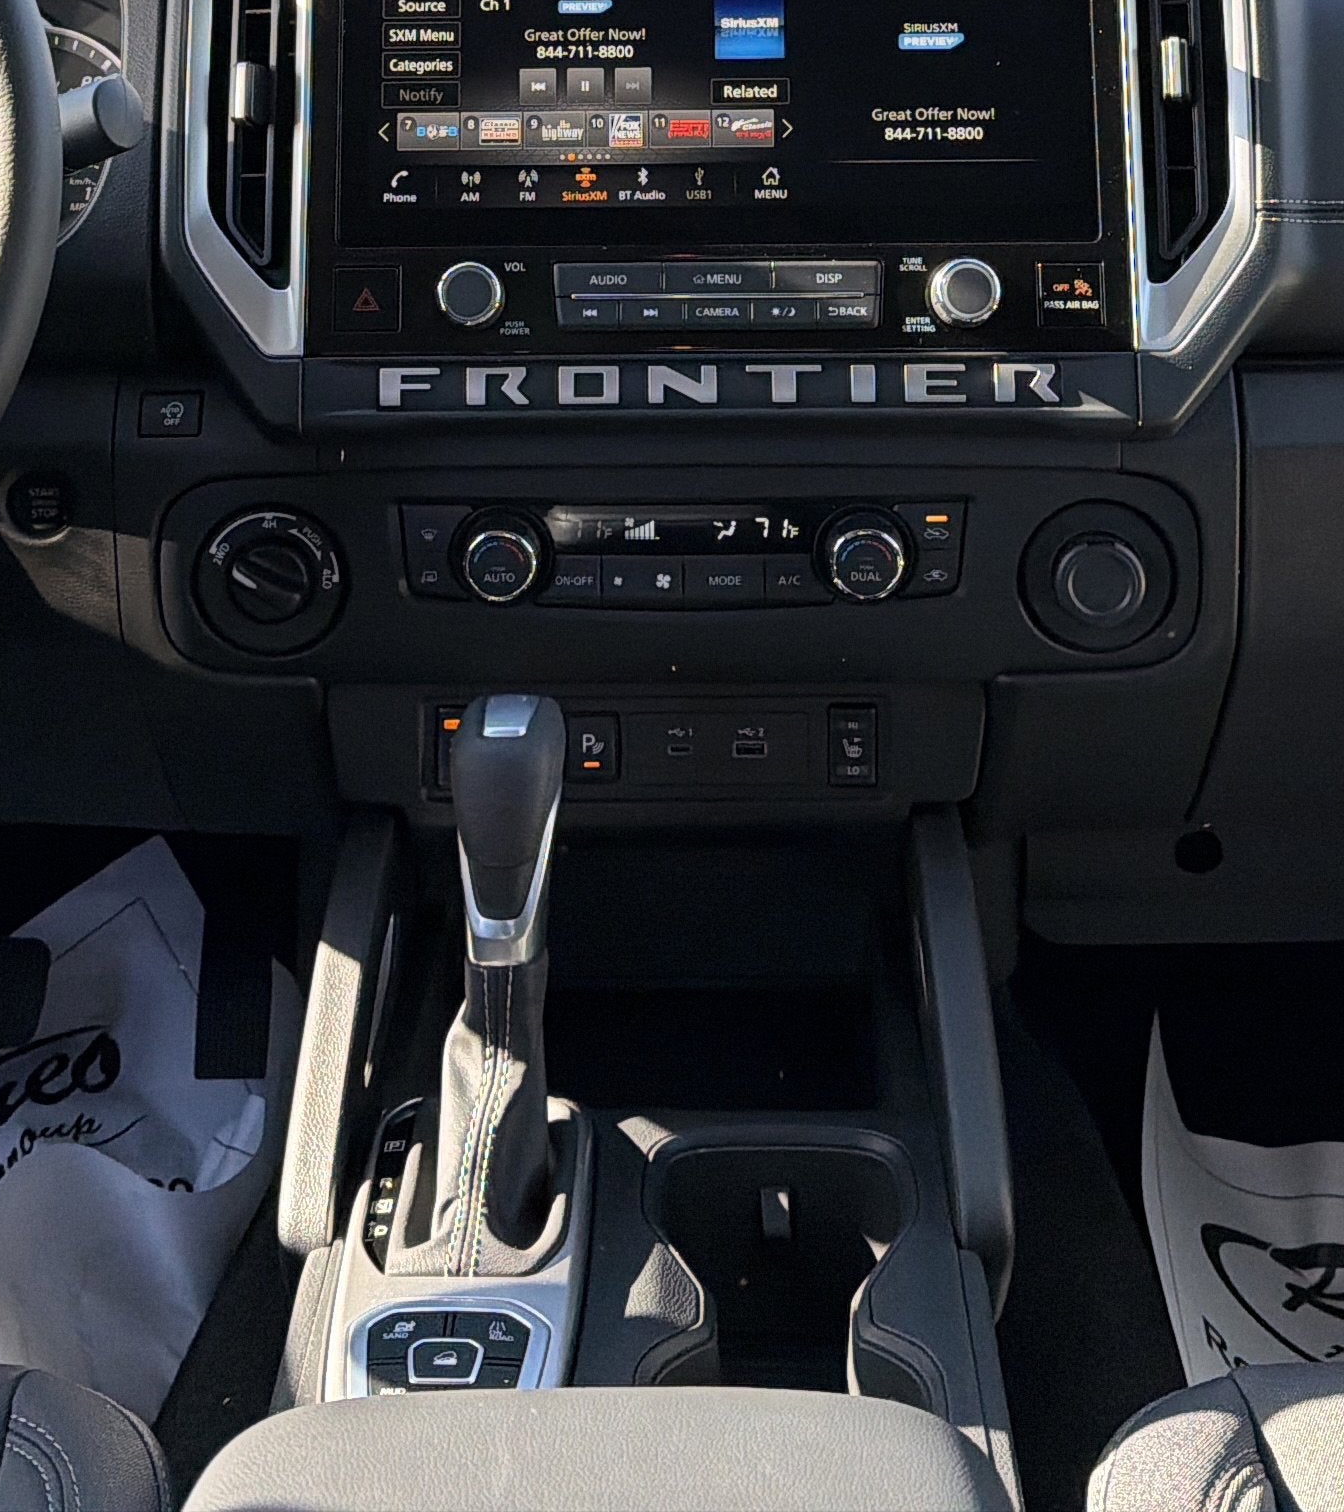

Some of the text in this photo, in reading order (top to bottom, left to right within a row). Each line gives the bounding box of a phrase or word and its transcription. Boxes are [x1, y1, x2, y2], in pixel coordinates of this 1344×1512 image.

[398, 0, 446, 12] Source
[720, 17, 780, 29] SiriusXM
[389, 28, 454, 42] SXM Menu
[524, 28, 646, 42] Great Offer Now!
[536, 44, 634, 59] 844-711-8800
[389, 59, 453, 76] Categories
[399, 89, 444, 103] Notify
[723, 85, 778, 98] Related
[871, 107, 995, 121] Great Offer Now!
[404, 120, 412, 130] 7
[467, 119, 475, 130] 8
[530, 119, 538, 130] 9
[591, 118, 604, 129] 10
[654, 117, 666, 128] 11
[717, 117, 729, 128] 12
[541, 125, 584, 141] highway
[616, 130, 641, 138] NEWS
[884, 127, 983, 141] 844-711-8800
[383, 192, 417, 203] Phone
[460, 192, 480, 202] AM
[519, 192, 536, 201] FM
[562, 191, 608, 202] SiriusXM
[618, 190, 666, 201] BT Audio
[686, 190, 712, 200] USB1
[754, 189, 788, 199] MENU
[903, 257, 923, 265] TUNE
[504, 262, 526, 273] VOL
[899, 264, 927, 272] SCROLL
[589, 274, 627, 285] AUDIO
[707, 273, 742, 284] MENU
[816, 273, 842, 284] DISP
[1053, 284, 1070, 292] OFF
[1044, 300, 1099, 309] PASS AIR BAG
[695, 307, 740, 317] CAMERA
[839, 306, 867, 316] BACK
[906, 317, 931, 325] ENTER
[499, 327, 530, 336] POWER
[902, 324, 936, 333] SETTING
[378, 363, 1060, 407] FRONTIER
[163, 418, 181, 426] OFF
[262, 520, 276, 528] 4H
[302, 527, 323, 546] PUSH
[213, 542, 230, 566] 2WD
[322, 569, 333, 589] 4LO
[483, 573, 515, 583] AUTO
[556, 576, 594, 586] ON-OFF
[709, 576, 741, 586] MODE
[778, 575, 800, 585] A/C
[851, 572, 882, 582] DUAL
[582, 733, 595, 754] P
[847, 766, 860, 776] LO
[382, 1332, 409, 1340] SAND
[380, 1387, 406, 1396] MUD
